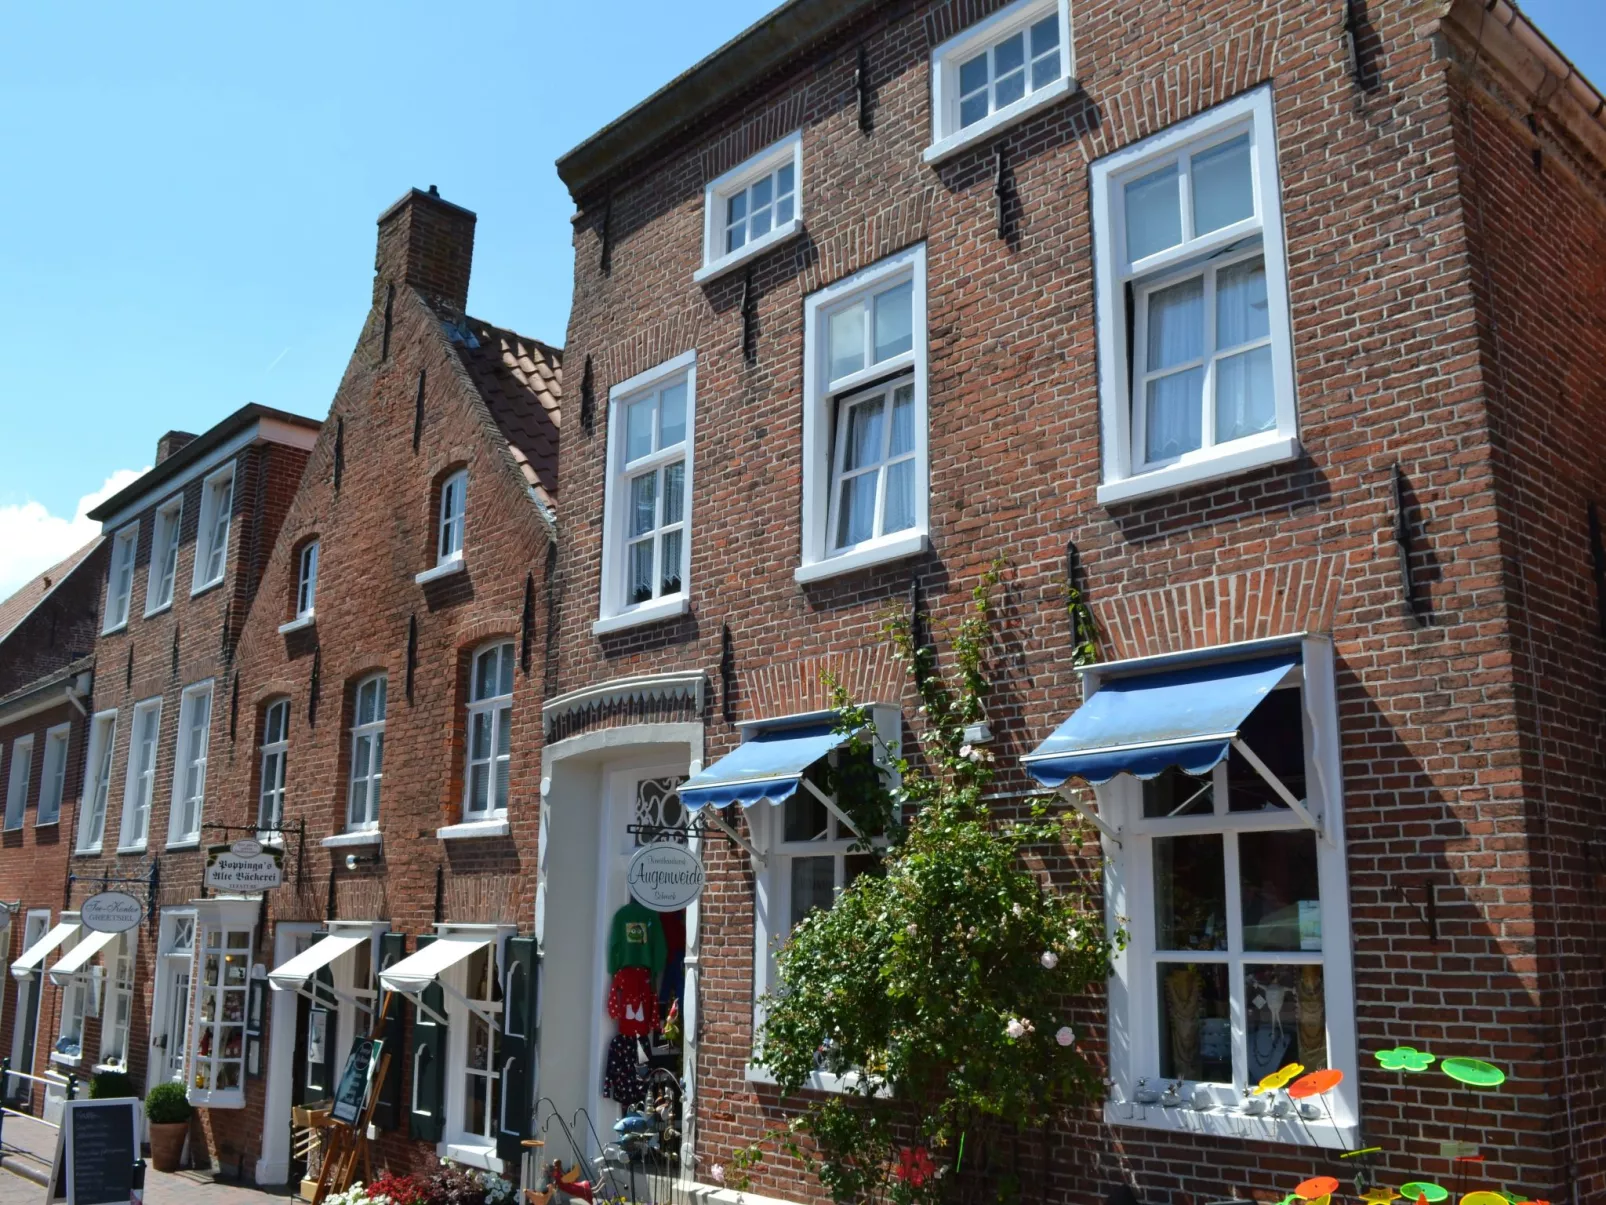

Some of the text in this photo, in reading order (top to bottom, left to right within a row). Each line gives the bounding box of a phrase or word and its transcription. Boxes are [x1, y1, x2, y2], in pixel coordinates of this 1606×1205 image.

[212, 872, 276, 881] Alte Bäckerei
[628, 862, 703, 890] Augenweide
